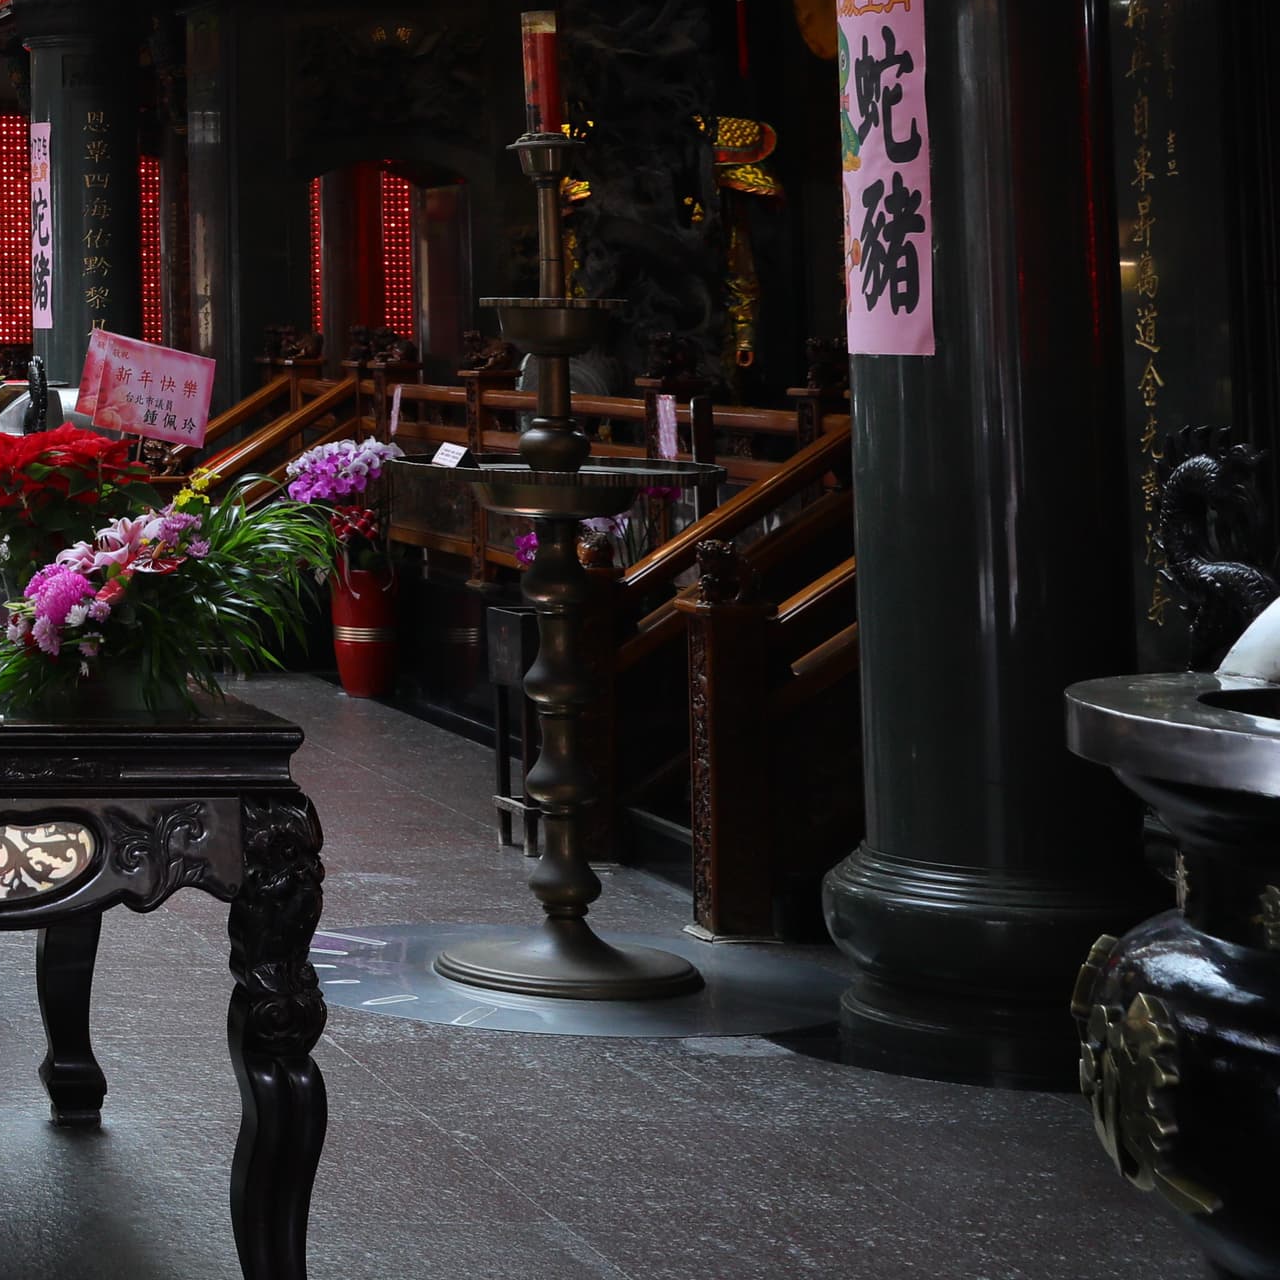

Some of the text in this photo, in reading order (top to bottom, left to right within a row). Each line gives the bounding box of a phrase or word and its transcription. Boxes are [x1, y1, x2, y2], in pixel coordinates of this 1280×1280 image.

[854, 25, 926, 316] 蛇豬
[115, 365, 199, 399] 新年快樂
[125, 391, 174, 413] 台北市議員
